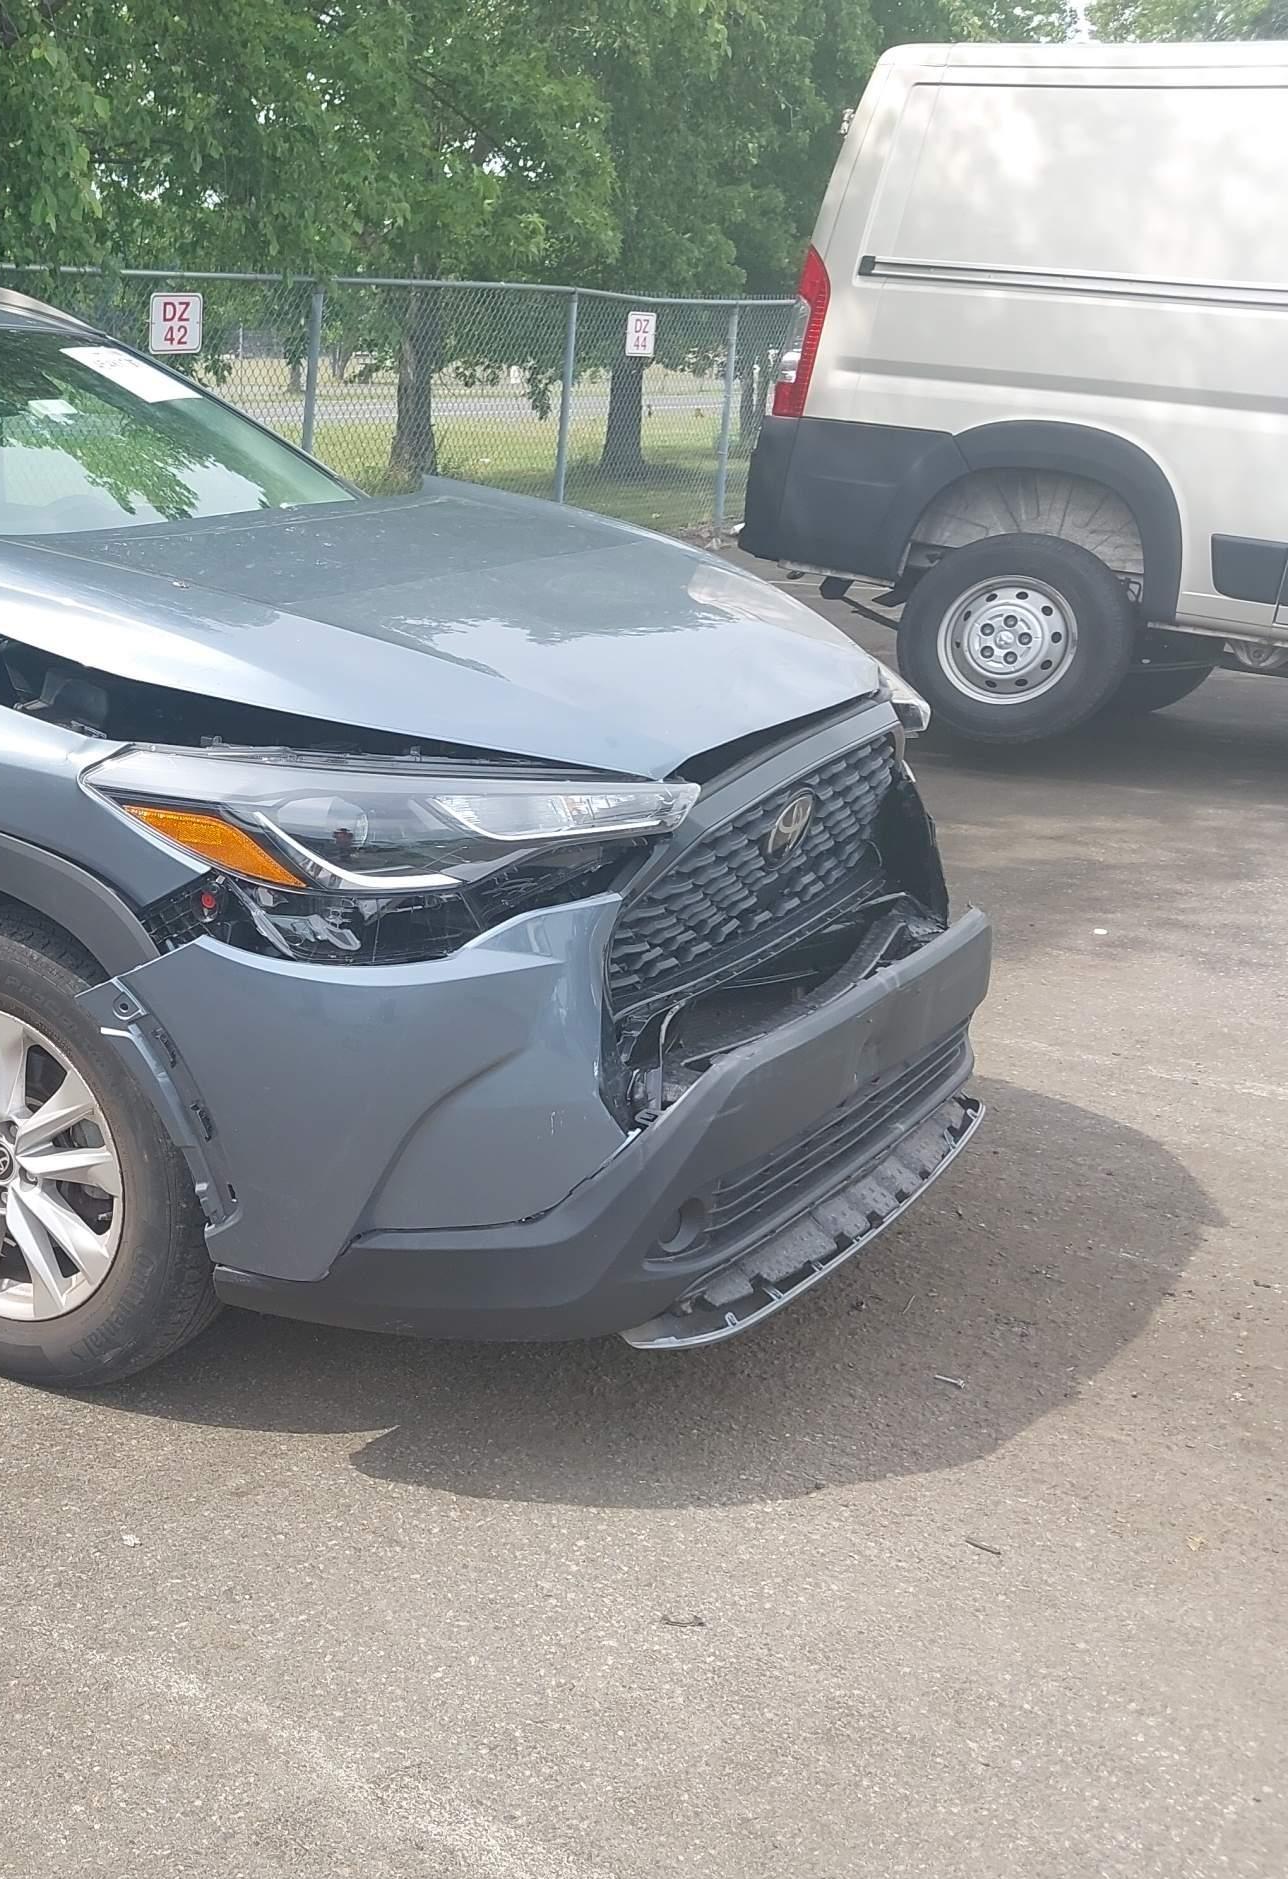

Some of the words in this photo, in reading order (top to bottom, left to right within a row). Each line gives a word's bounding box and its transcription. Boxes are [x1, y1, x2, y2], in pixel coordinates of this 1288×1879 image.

[163, 301, 191, 322] DZ
[634, 318, 650, 334] DZ
[164, 325, 188, 346] 42
[633, 335, 647, 351] 44
